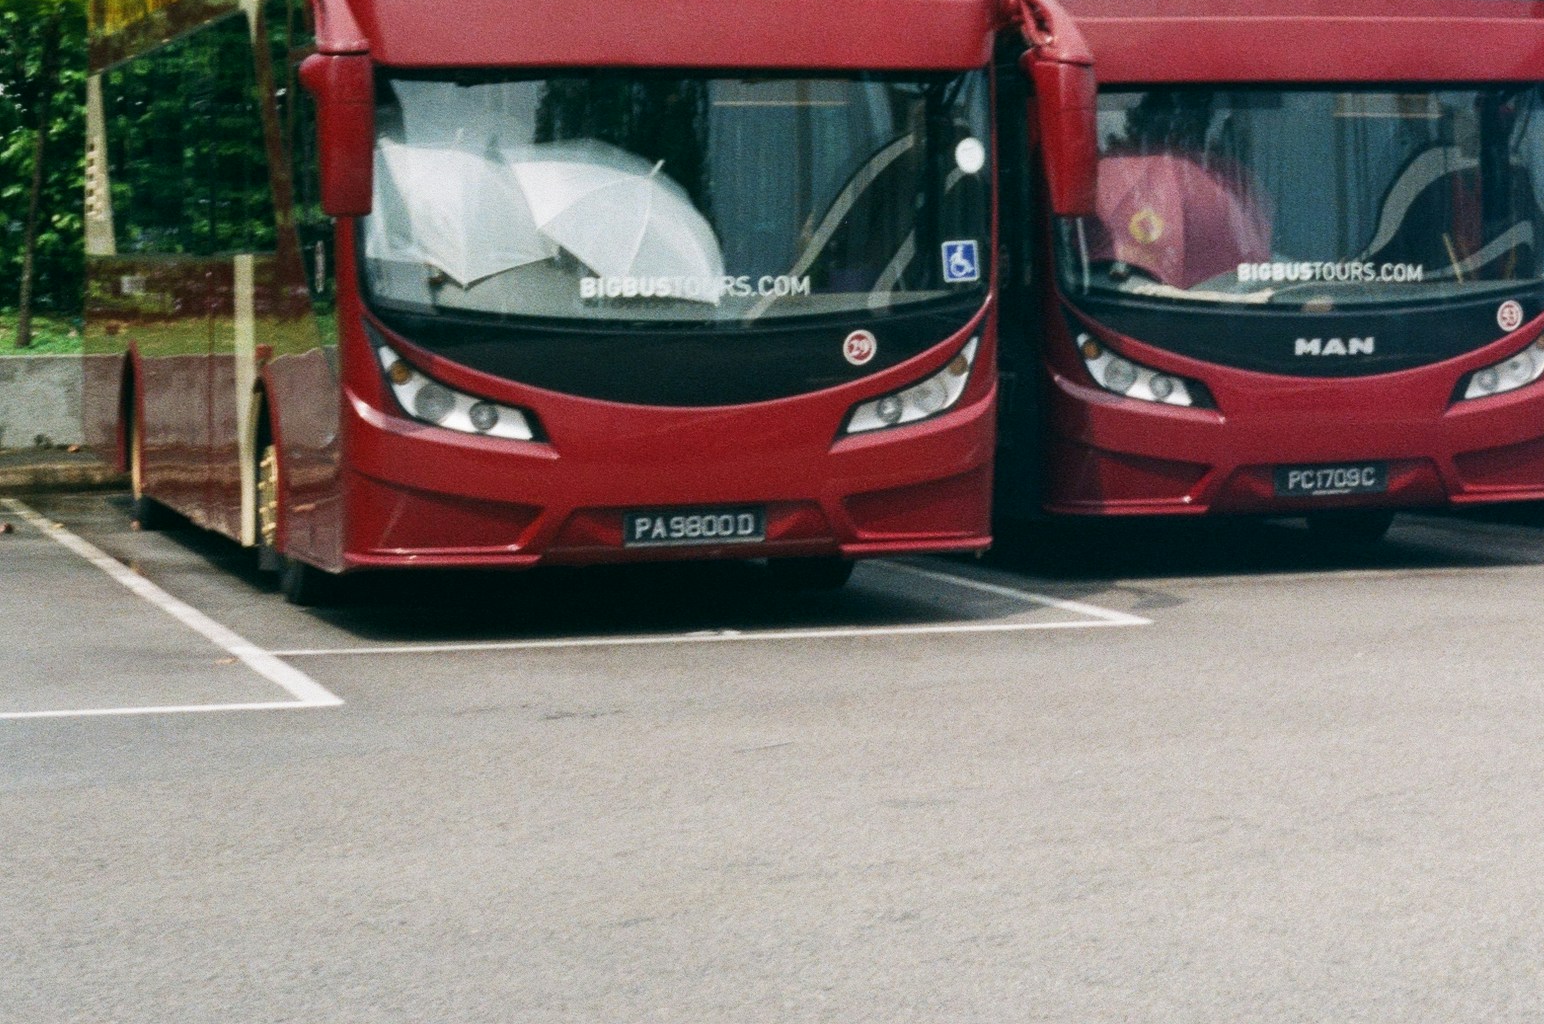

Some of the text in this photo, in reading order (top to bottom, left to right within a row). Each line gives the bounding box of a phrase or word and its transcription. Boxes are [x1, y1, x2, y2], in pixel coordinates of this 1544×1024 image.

[1237, 262, 1423, 282] BIGBUSTOURS.COM
[580, 275, 810, 298] BIGBUSTORS.COM
[1295, 337, 1375, 356] MAN
[1288, 467, 1376, 489] PC1709C
[635, 514, 754, 539] PA9800D
